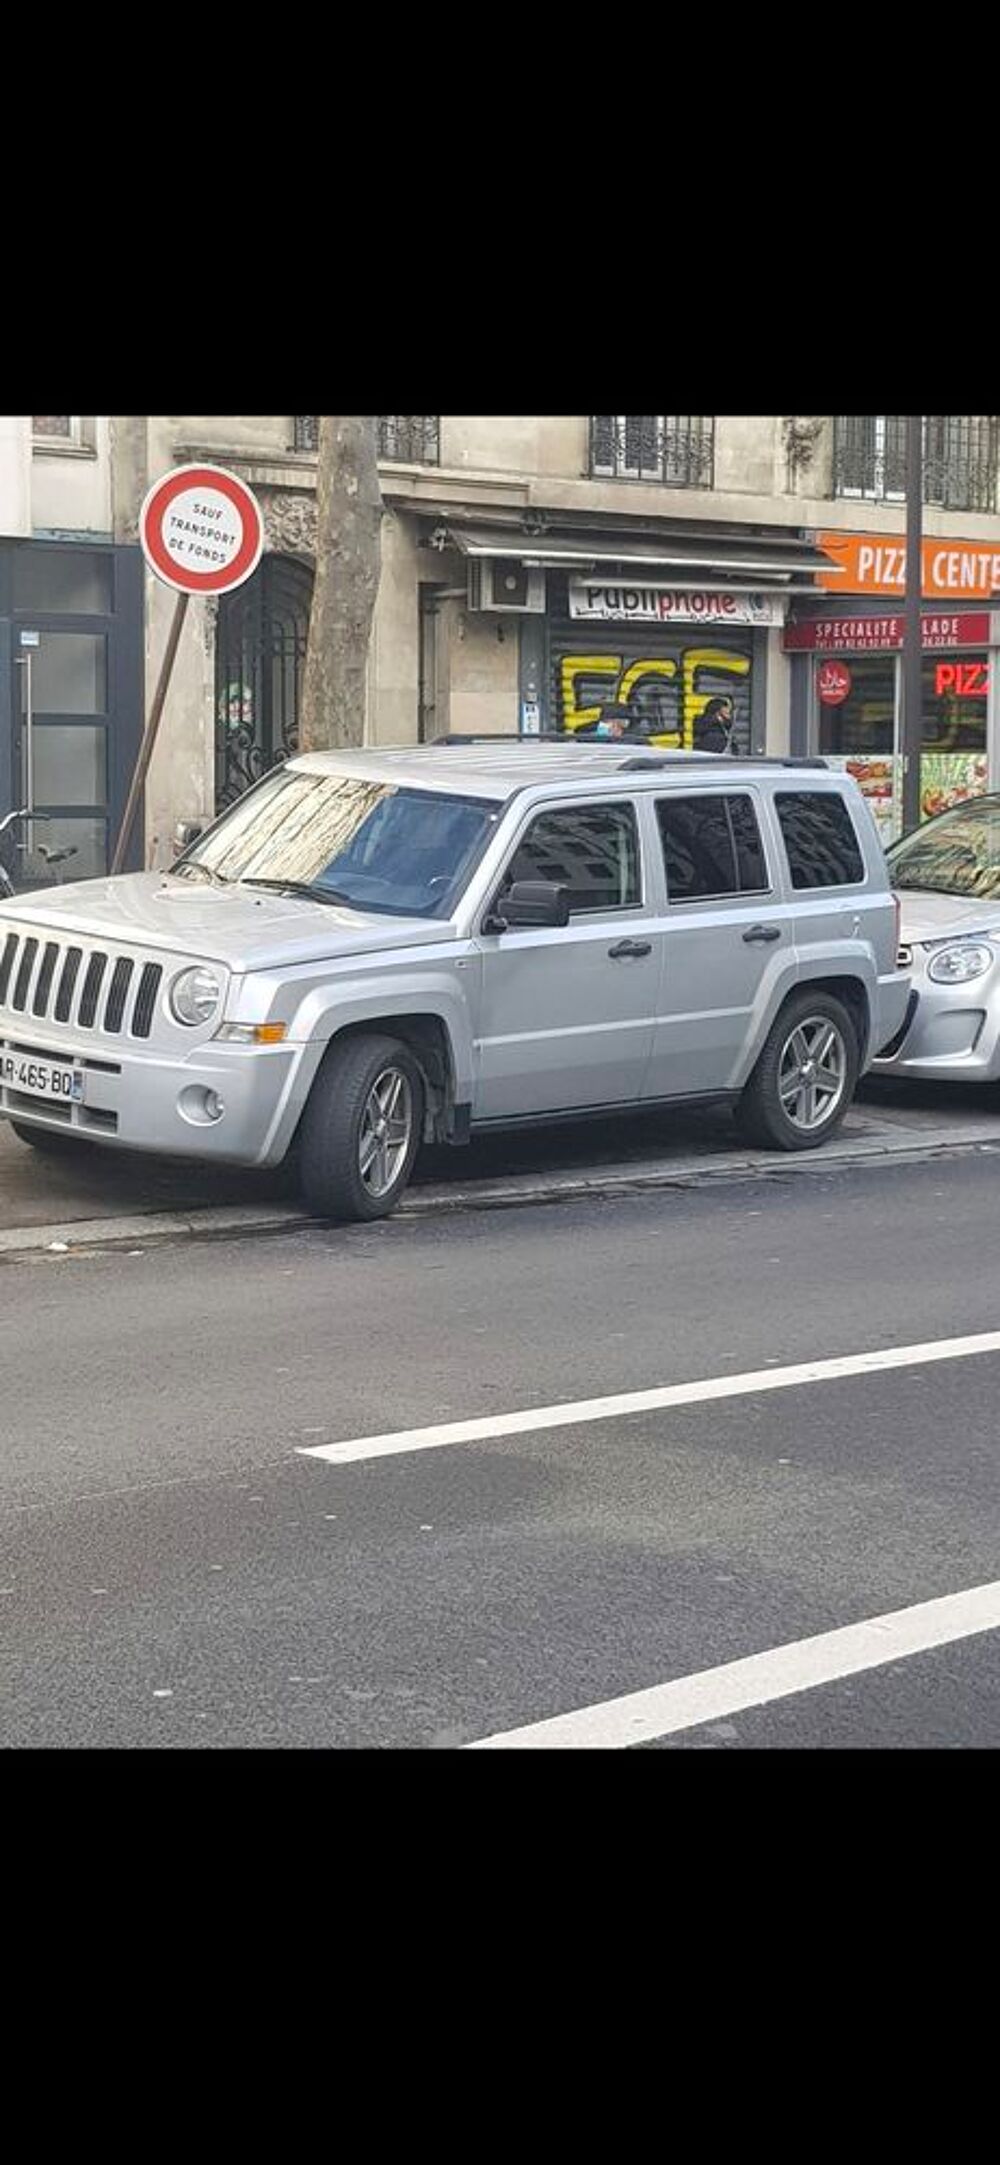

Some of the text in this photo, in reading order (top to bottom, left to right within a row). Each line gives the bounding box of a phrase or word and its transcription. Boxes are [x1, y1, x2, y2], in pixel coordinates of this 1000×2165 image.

[192, 504, 223, 520] SAUF
[170, 516, 236, 546] TRANSPORT
[169, 537, 226, 564] DE FONDS
[858, 545, 1000, 590] PIZZ CENTE
[587, 585, 737, 619] Publiphone
[815, 619, 898, 638] SPECIALITÉ
